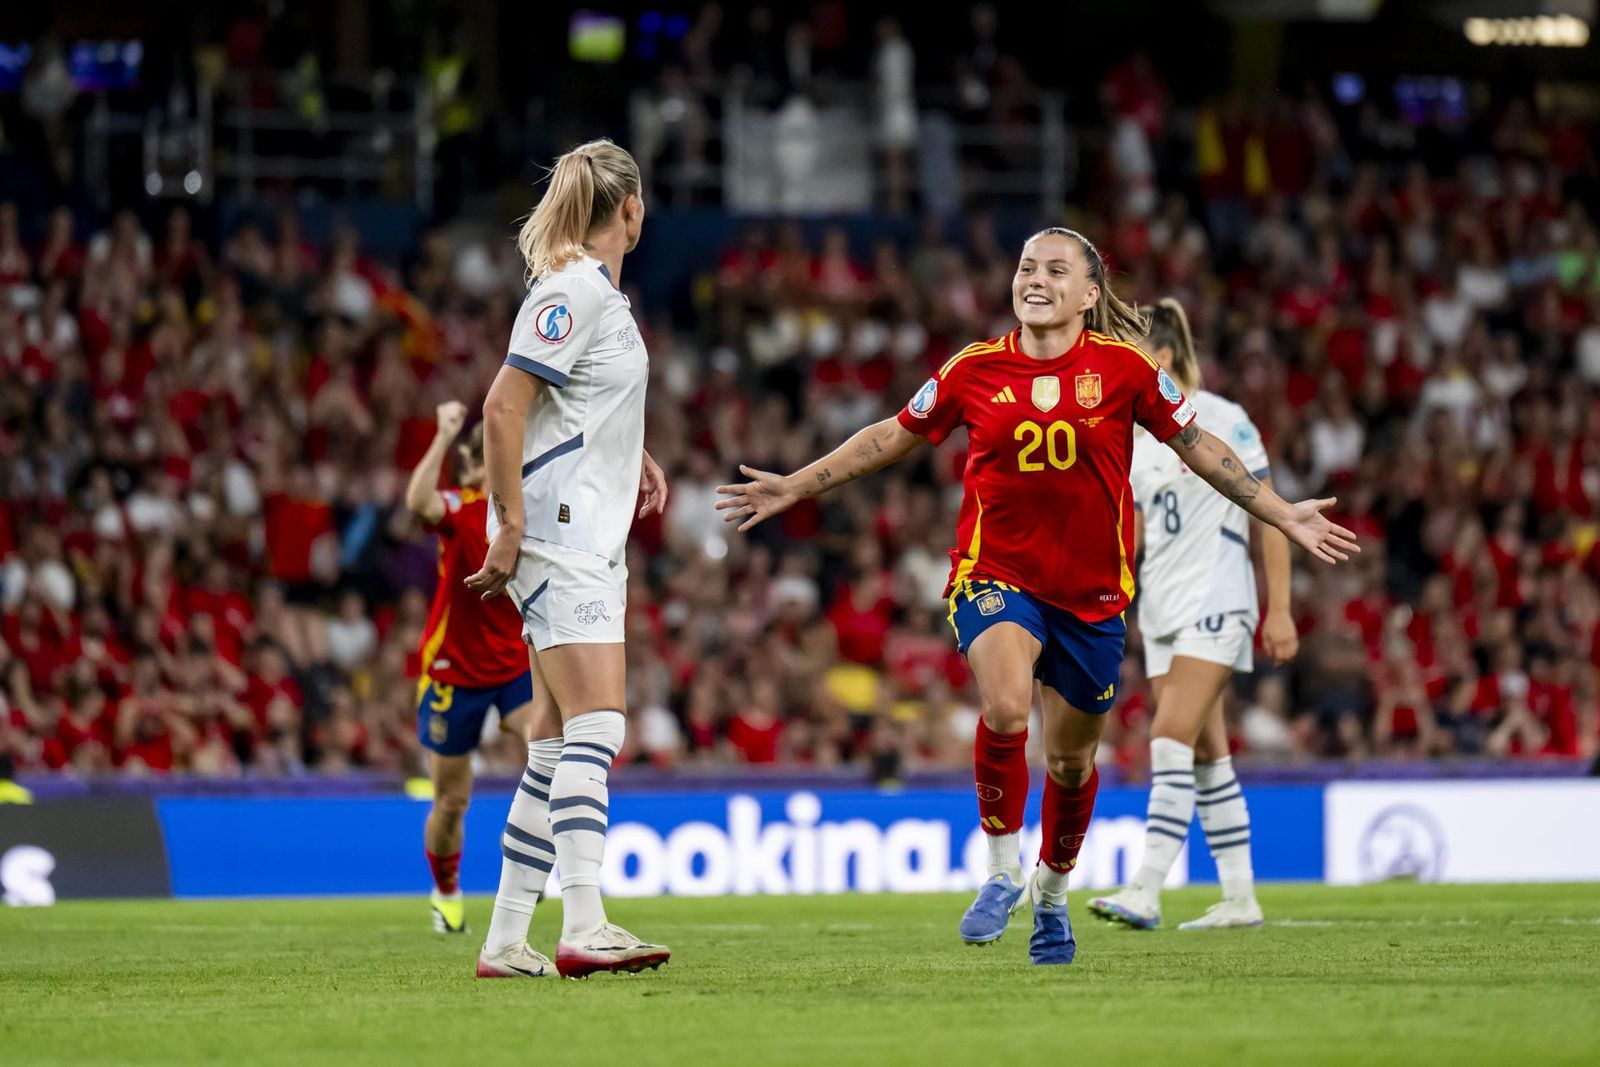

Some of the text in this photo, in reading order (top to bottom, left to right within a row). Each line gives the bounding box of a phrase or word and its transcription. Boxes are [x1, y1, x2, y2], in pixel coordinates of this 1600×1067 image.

[1014, 420, 1077, 472] 20
[1153, 490, 1181, 534] 8
[429, 680, 454, 713] 9
